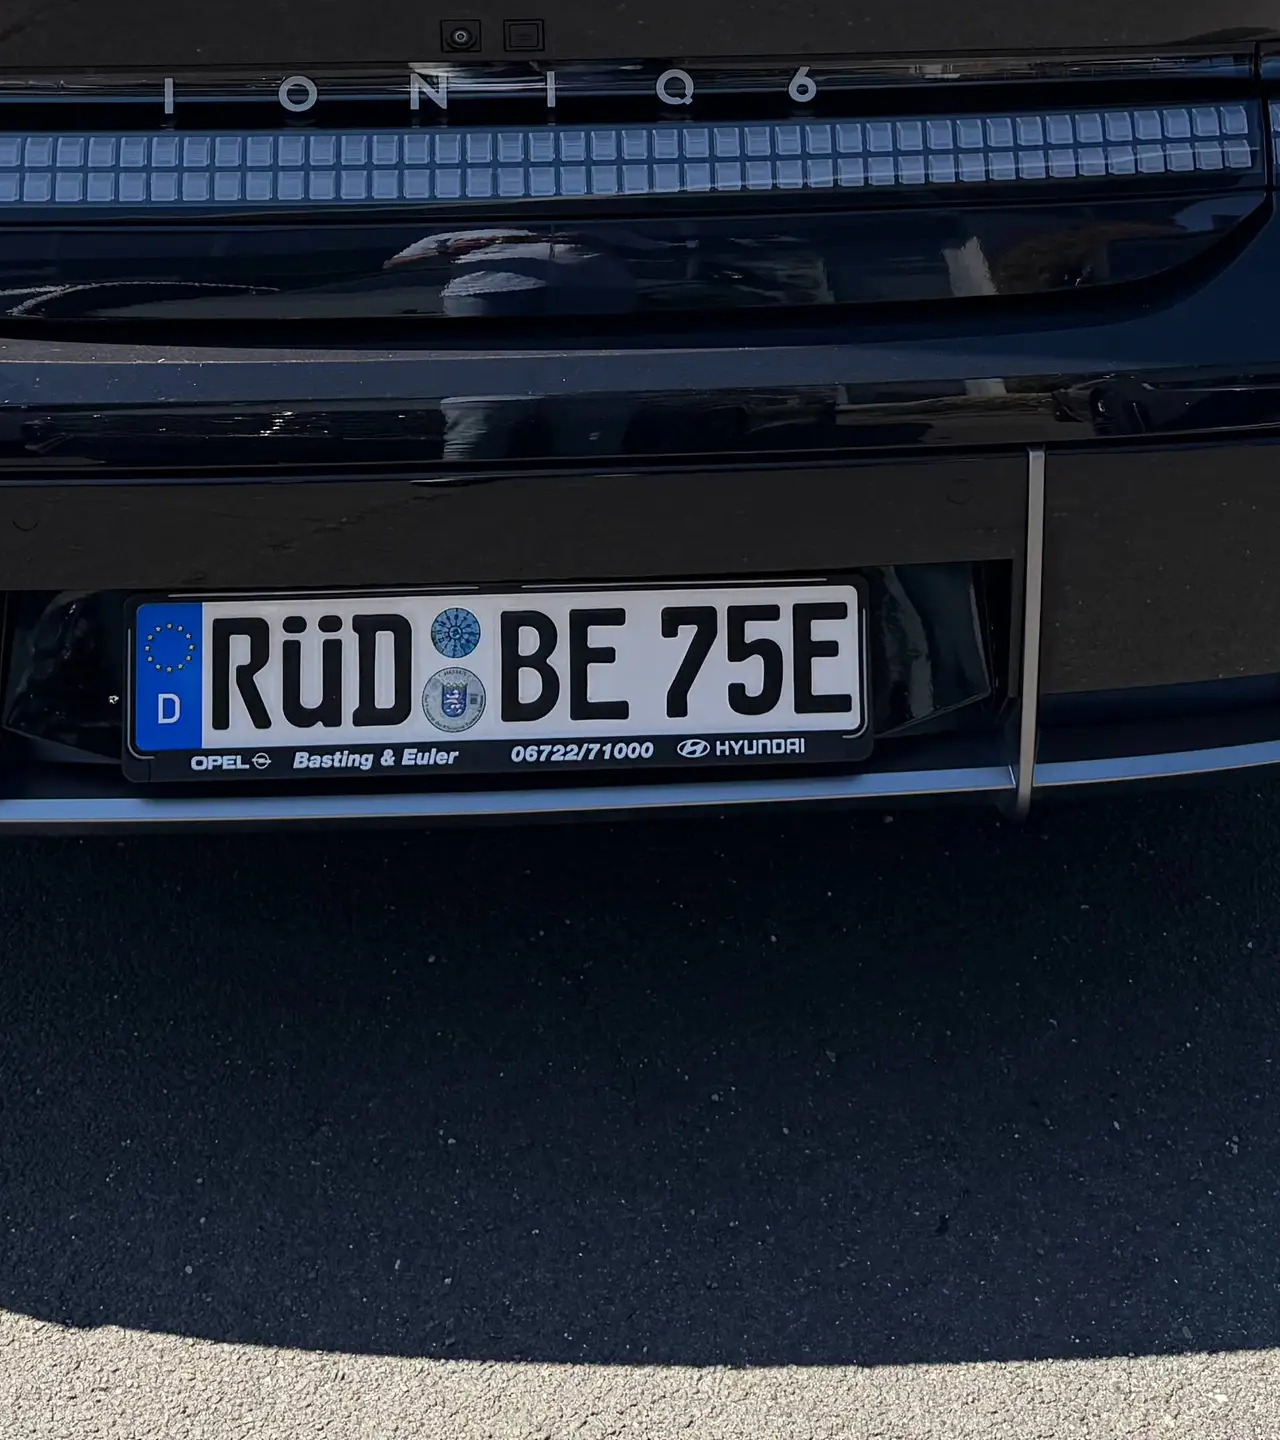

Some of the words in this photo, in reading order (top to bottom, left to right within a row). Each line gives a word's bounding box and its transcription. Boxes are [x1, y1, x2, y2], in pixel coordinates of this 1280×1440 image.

[788, 66, 817, 103] 6
[500, 607, 630, 723] BE
[661, 601, 853, 719] 75E
[157, 693, 181, 724] D
[511, 741, 655, 763] 06722/71000
[716, 737, 806, 756] HYUNDAI
[191, 755, 250, 771] OPEL
[293, 750, 374, 771] Basting
[380, 750, 395, 768] &
[402, 748, 460, 767] Euler
